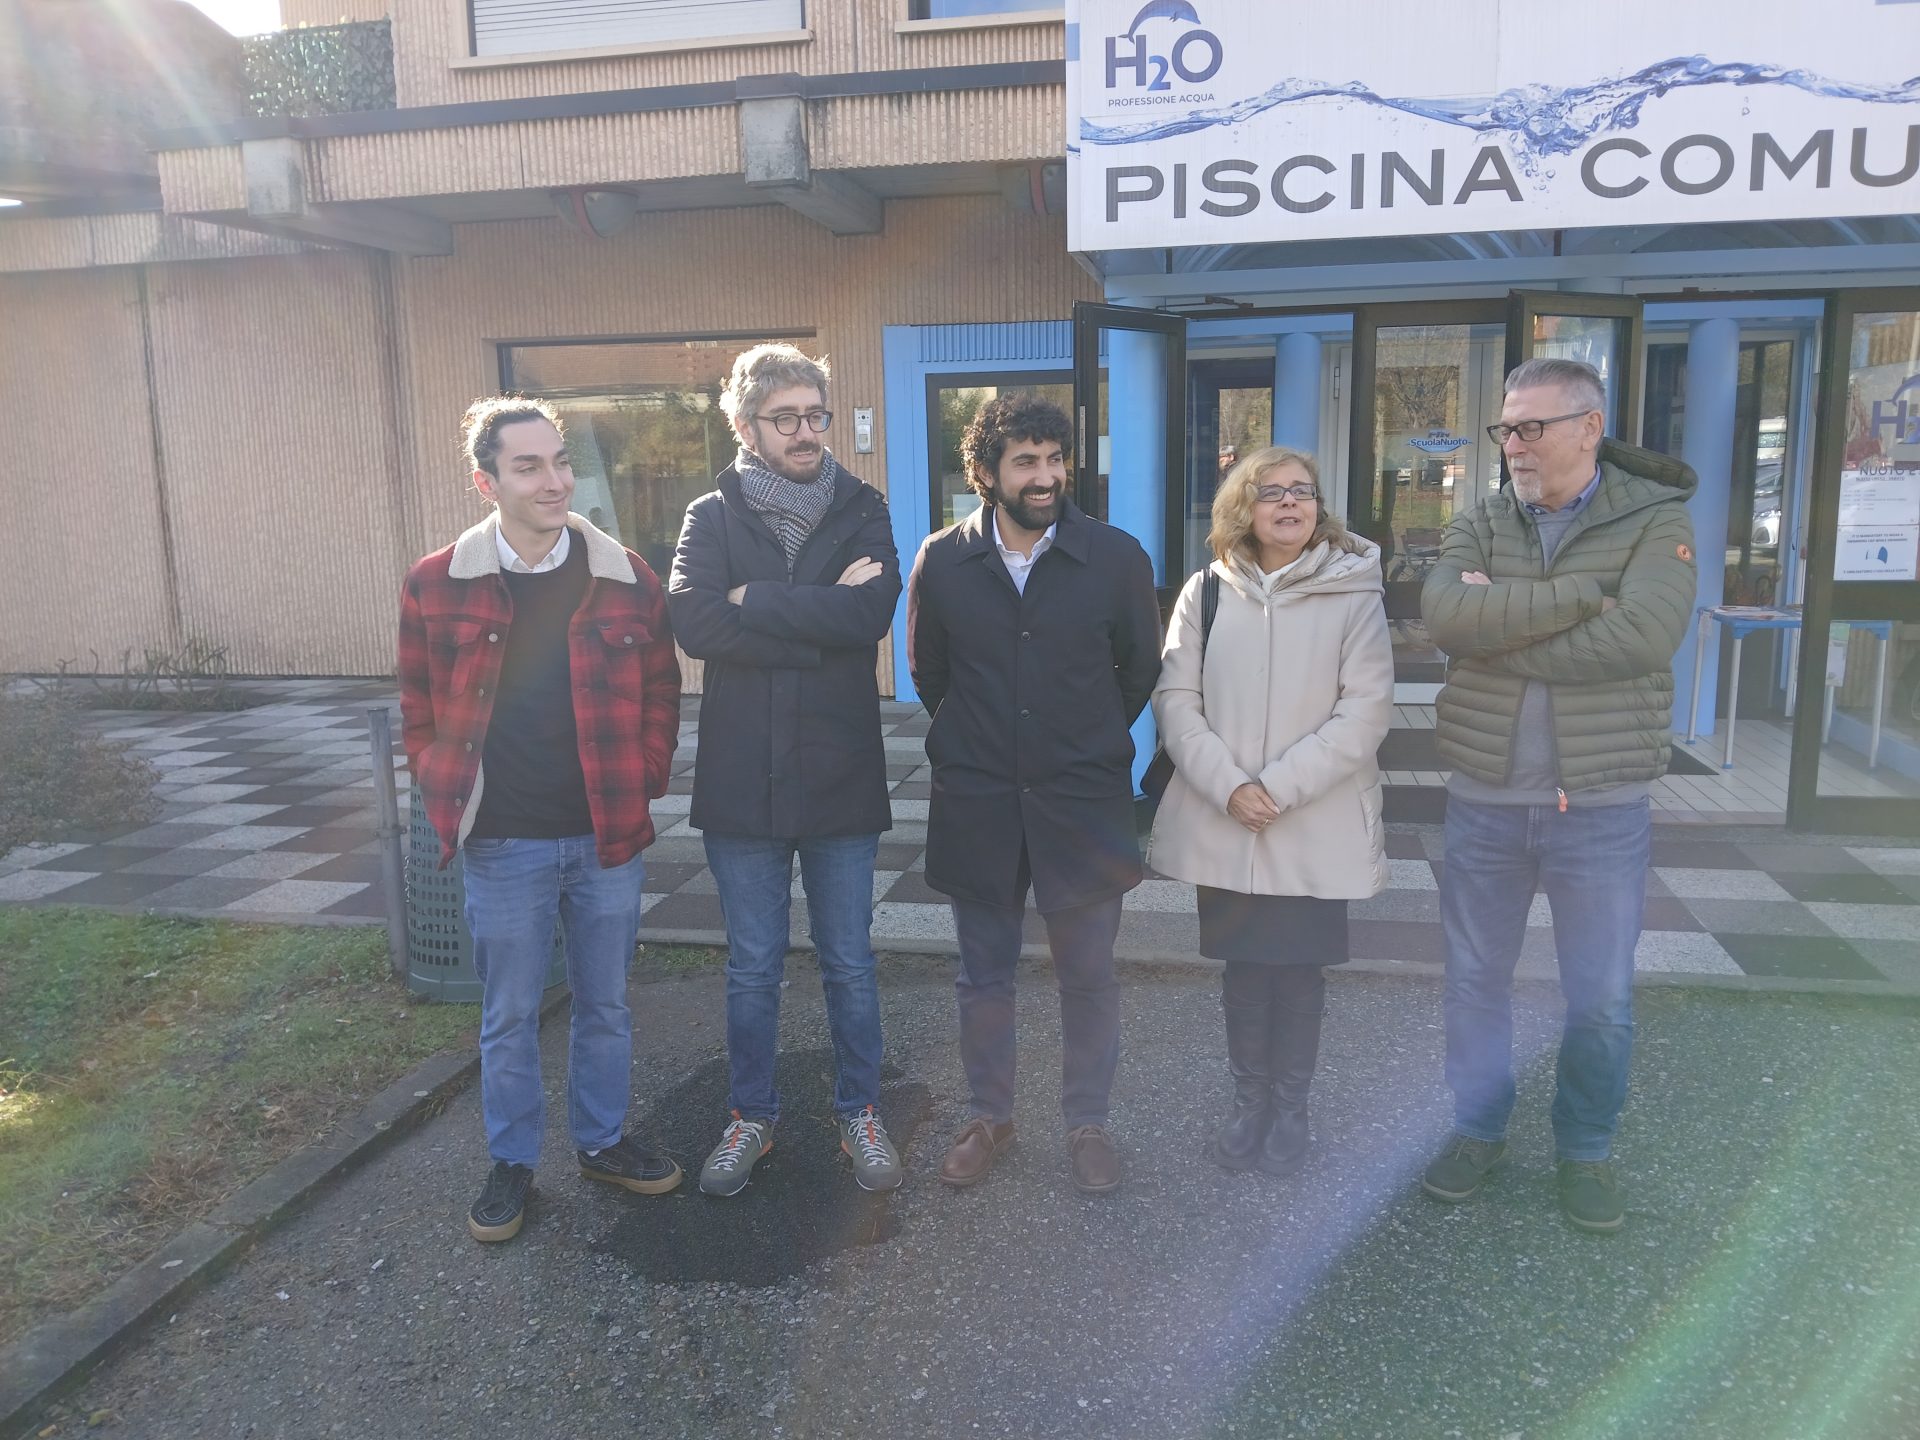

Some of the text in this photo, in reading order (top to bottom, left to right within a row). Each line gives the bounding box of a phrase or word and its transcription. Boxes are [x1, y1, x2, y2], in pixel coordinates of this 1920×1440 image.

[1103, 28, 1223, 91] H2O
[1108, 93, 1215, 107] PROFESSIONE ACQUA
[1105, 145, 1524, 223] PISCINA
[1860, 465, 1905, 476] NUOTO
